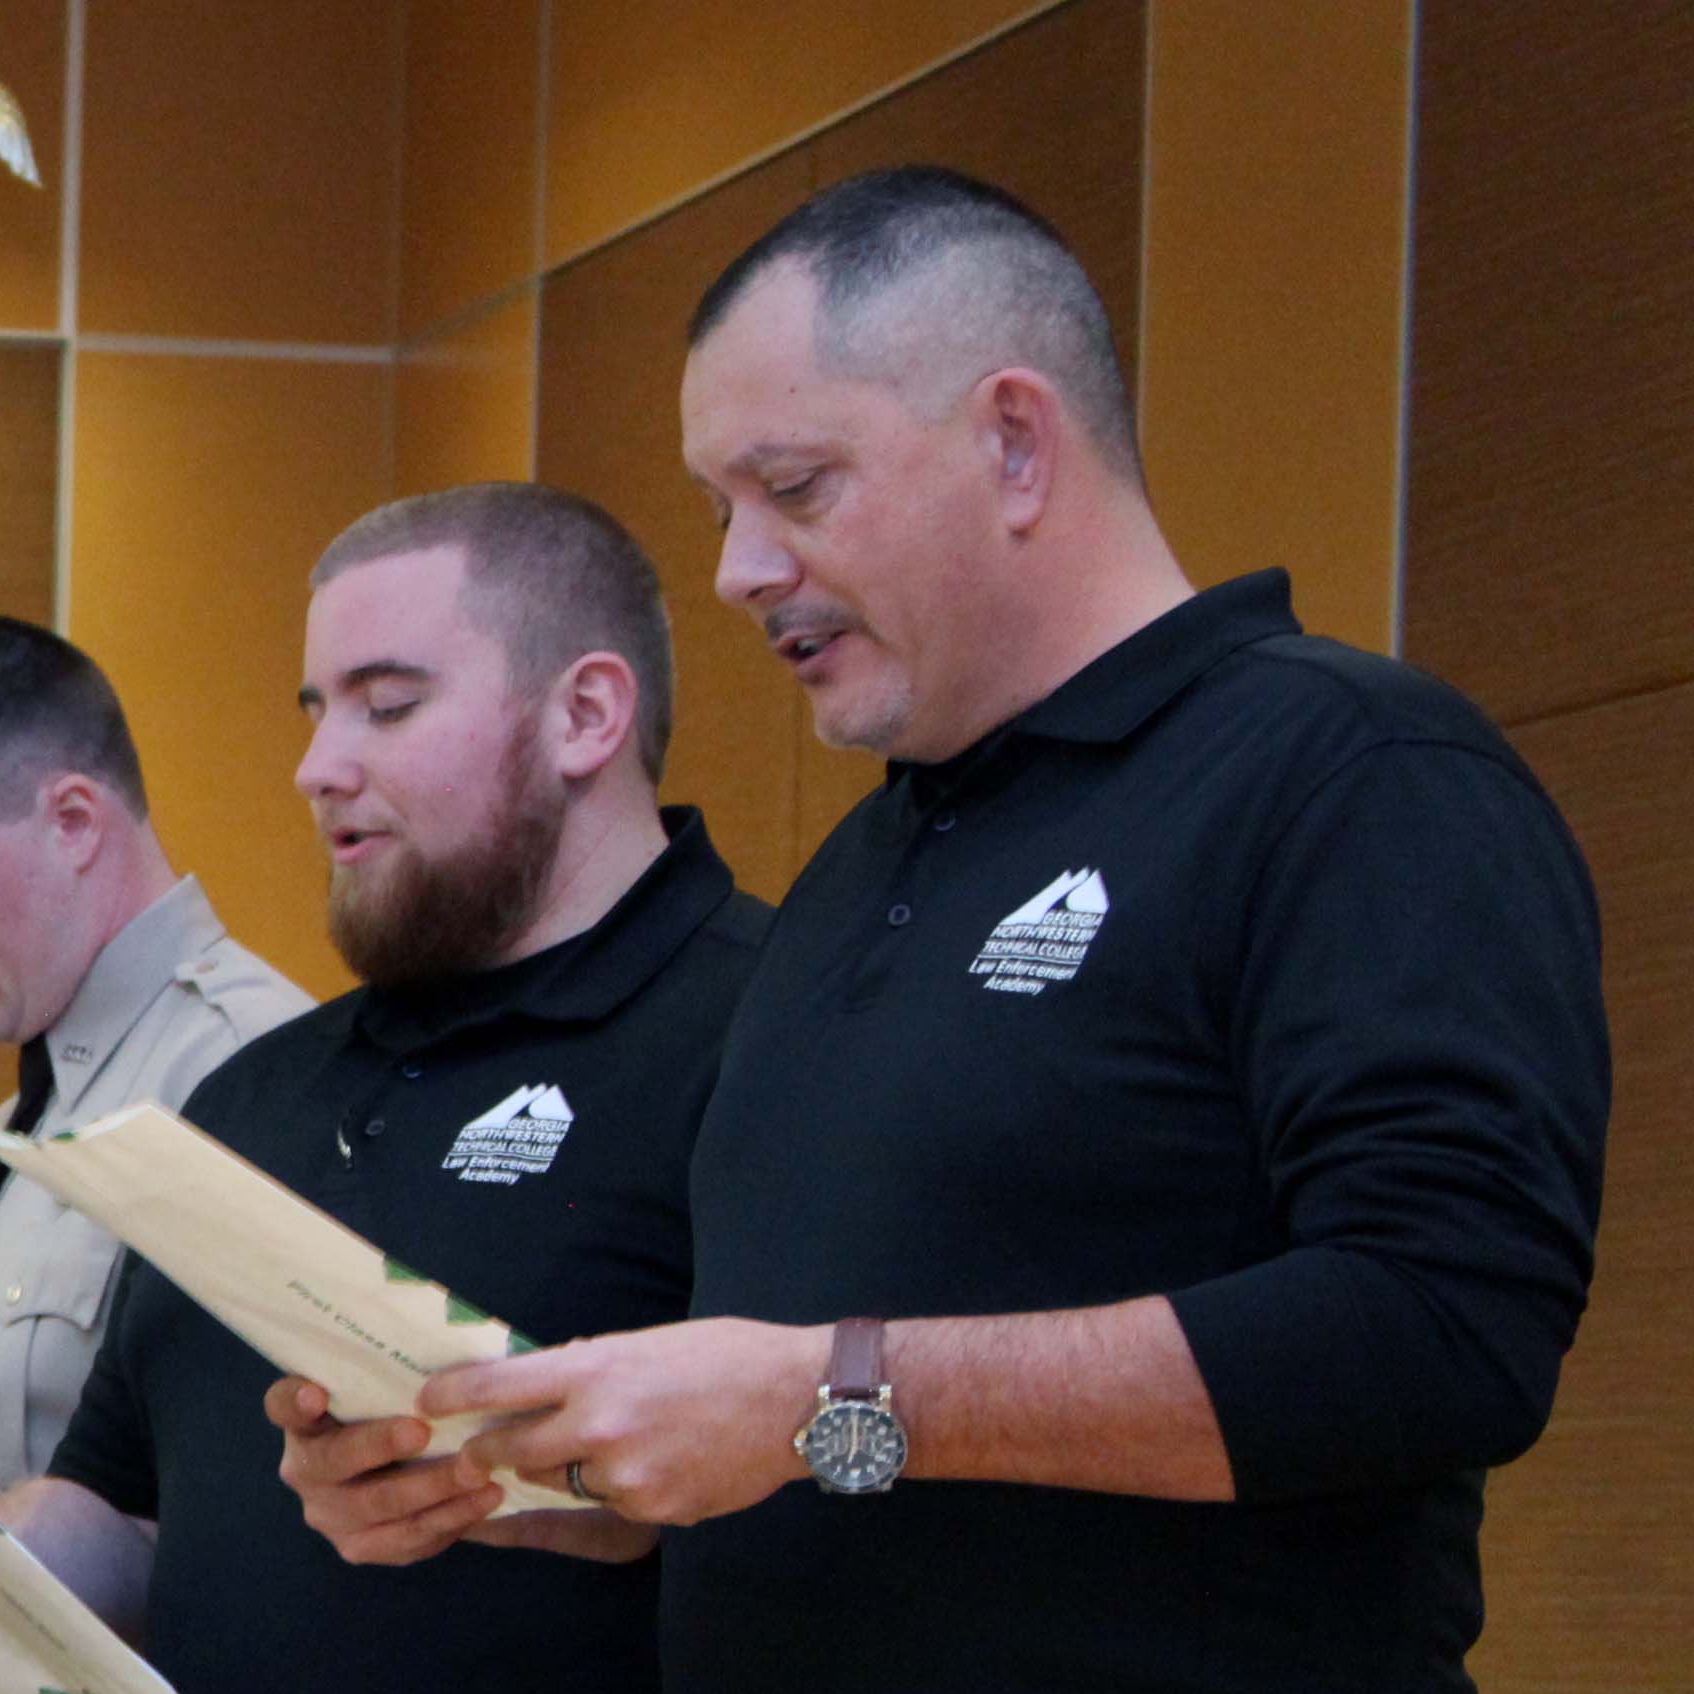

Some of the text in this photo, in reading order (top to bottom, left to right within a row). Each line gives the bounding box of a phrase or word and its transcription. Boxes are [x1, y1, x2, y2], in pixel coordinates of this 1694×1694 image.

[1041, 911, 1104, 929] GEORGIA
[991, 925, 1097, 943] NORTHWESTERN
[982, 940, 1089, 959] TECHNICAL COLLEGE
[968, 959, 1079, 980] Law Enforcement
[983, 975, 1046, 996] Academy
[508, 1117, 571, 1132] GEORGIA
[460, 1128, 566, 1144] NORTHWESTERN
[452, 1141, 560, 1158] TECHNICAL COLLEGE
[441, 1154, 552, 1174] Law Enforcement
[458, 1168, 521, 1186] Academy
